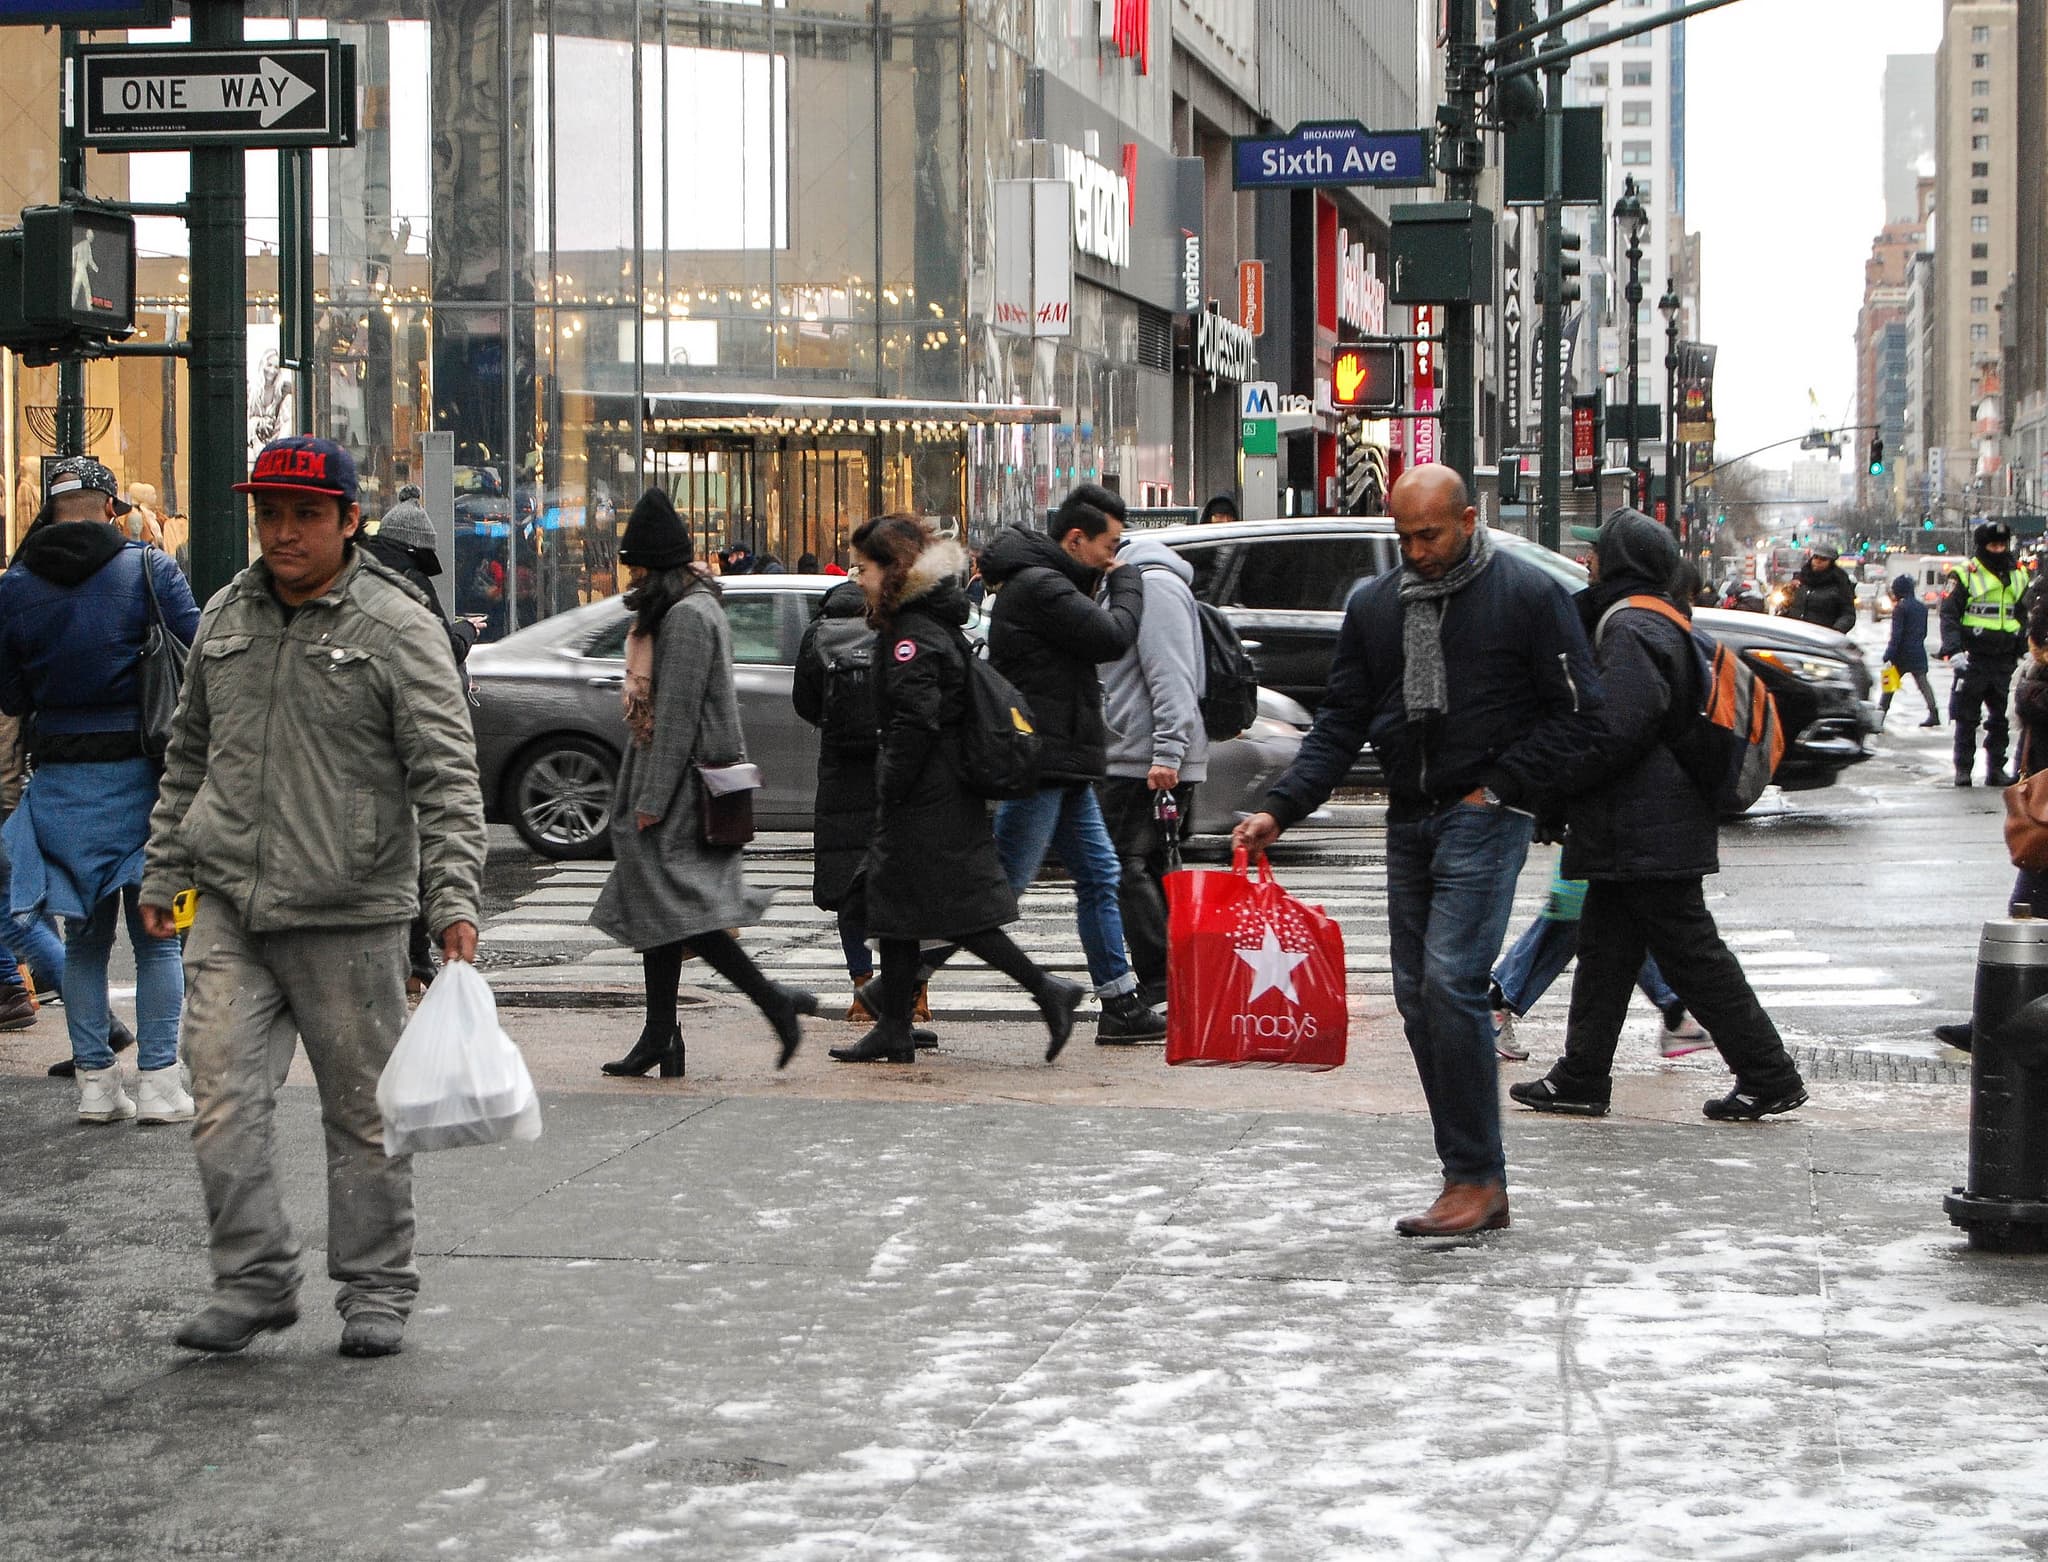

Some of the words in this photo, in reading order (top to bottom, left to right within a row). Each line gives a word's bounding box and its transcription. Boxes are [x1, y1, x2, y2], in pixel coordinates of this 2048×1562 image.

[122, 80, 187, 110] ONE
[221, 77, 289, 107] WAY
[1303, 129, 1356, 140] BROADWAY
[1262, 146, 1333, 176] Sixth
[1342, 146, 1397, 172] Ave
[1183, 236, 1200, 310] verizon
[1246, 282, 1257, 323] Payless
[1505, 268, 1520, 343] KAY
[1231, 1012, 1318, 1044] macy's
